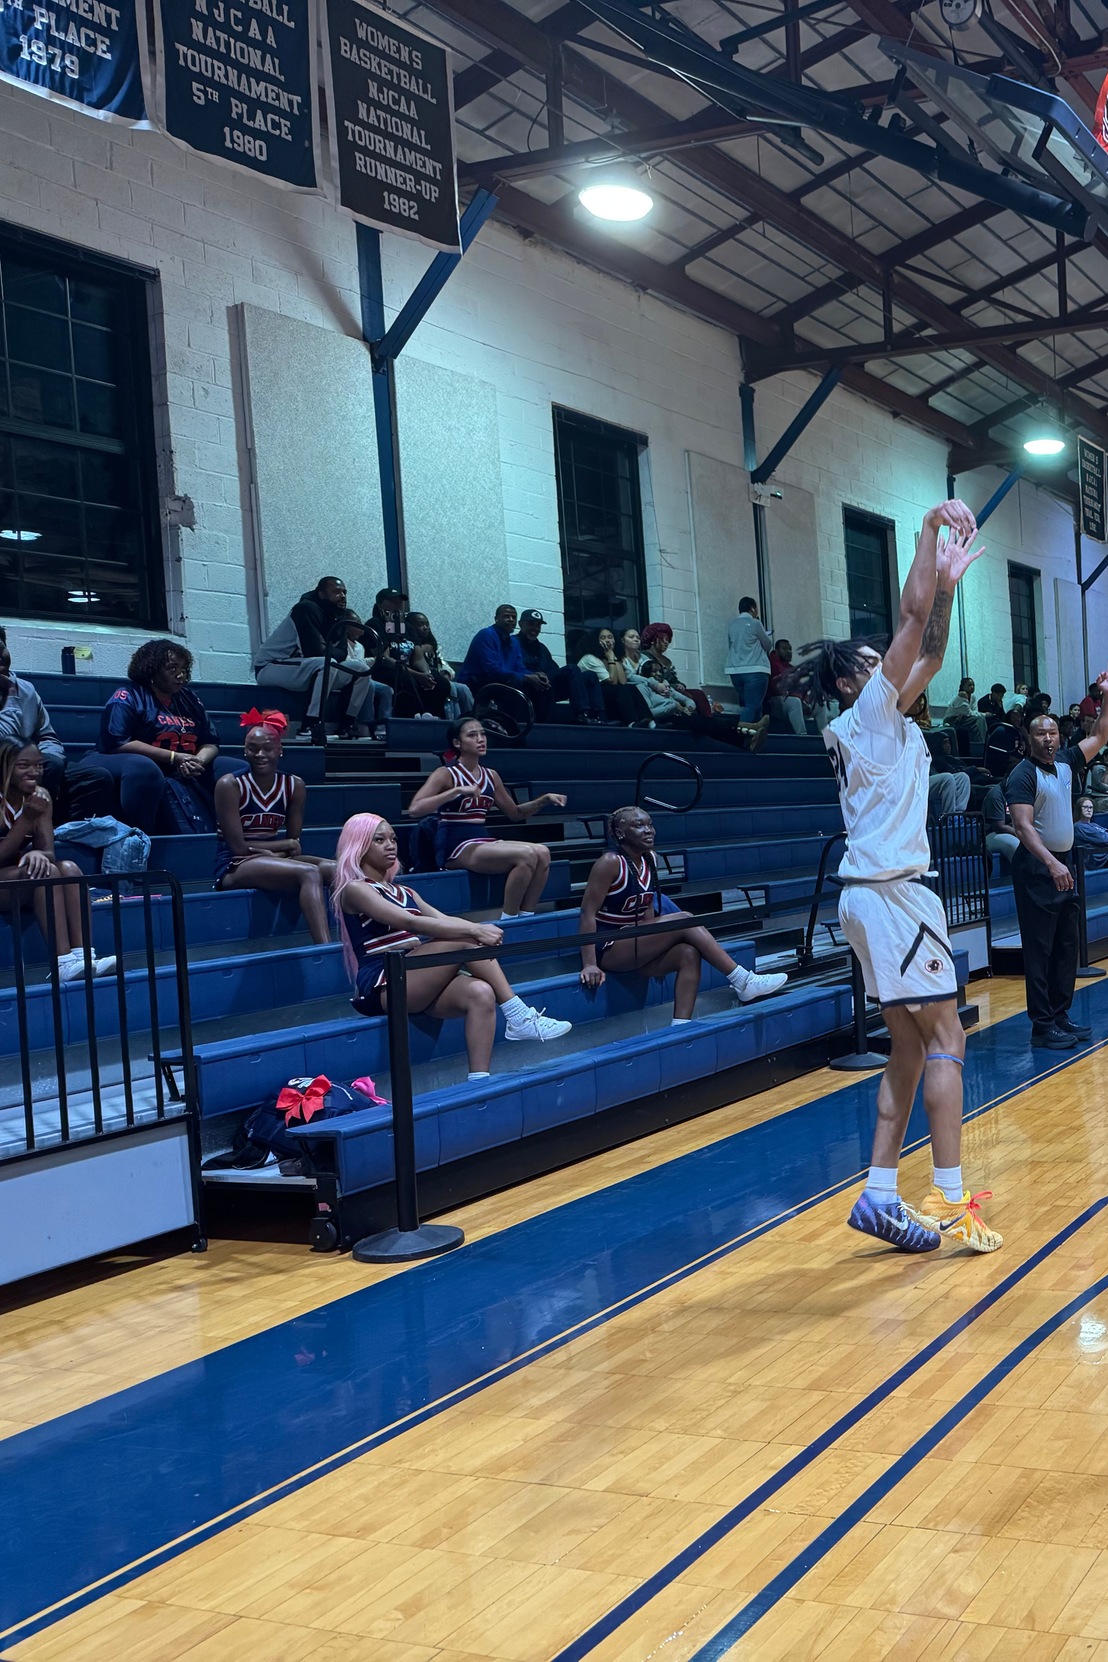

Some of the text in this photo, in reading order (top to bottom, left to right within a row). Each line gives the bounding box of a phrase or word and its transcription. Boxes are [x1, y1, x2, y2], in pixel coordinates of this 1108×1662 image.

[20, 34, 79, 79] 1979
[33, 4, 112, 60] PLACE
[190, 18, 285, 82] NATIONAL
[354, 18, 422, 71] WOMEN'S
[174, 42, 301, 115] TOURNAMENT
[339, 36, 436, 105] BASKETBALL
[192, 81, 292, 141] 5TH PLACE
[357, 100, 431, 150] NATIONAL
[367, 79, 418, 120] NJCAA
[223, 126, 267, 161] 1980
[344, 120, 442, 180] TOURNAMENT
[354, 151, 439, 203] RUNNER-UP
[383, 191, 419, 221] 1982
[157, 715, 196, 727] CANES
